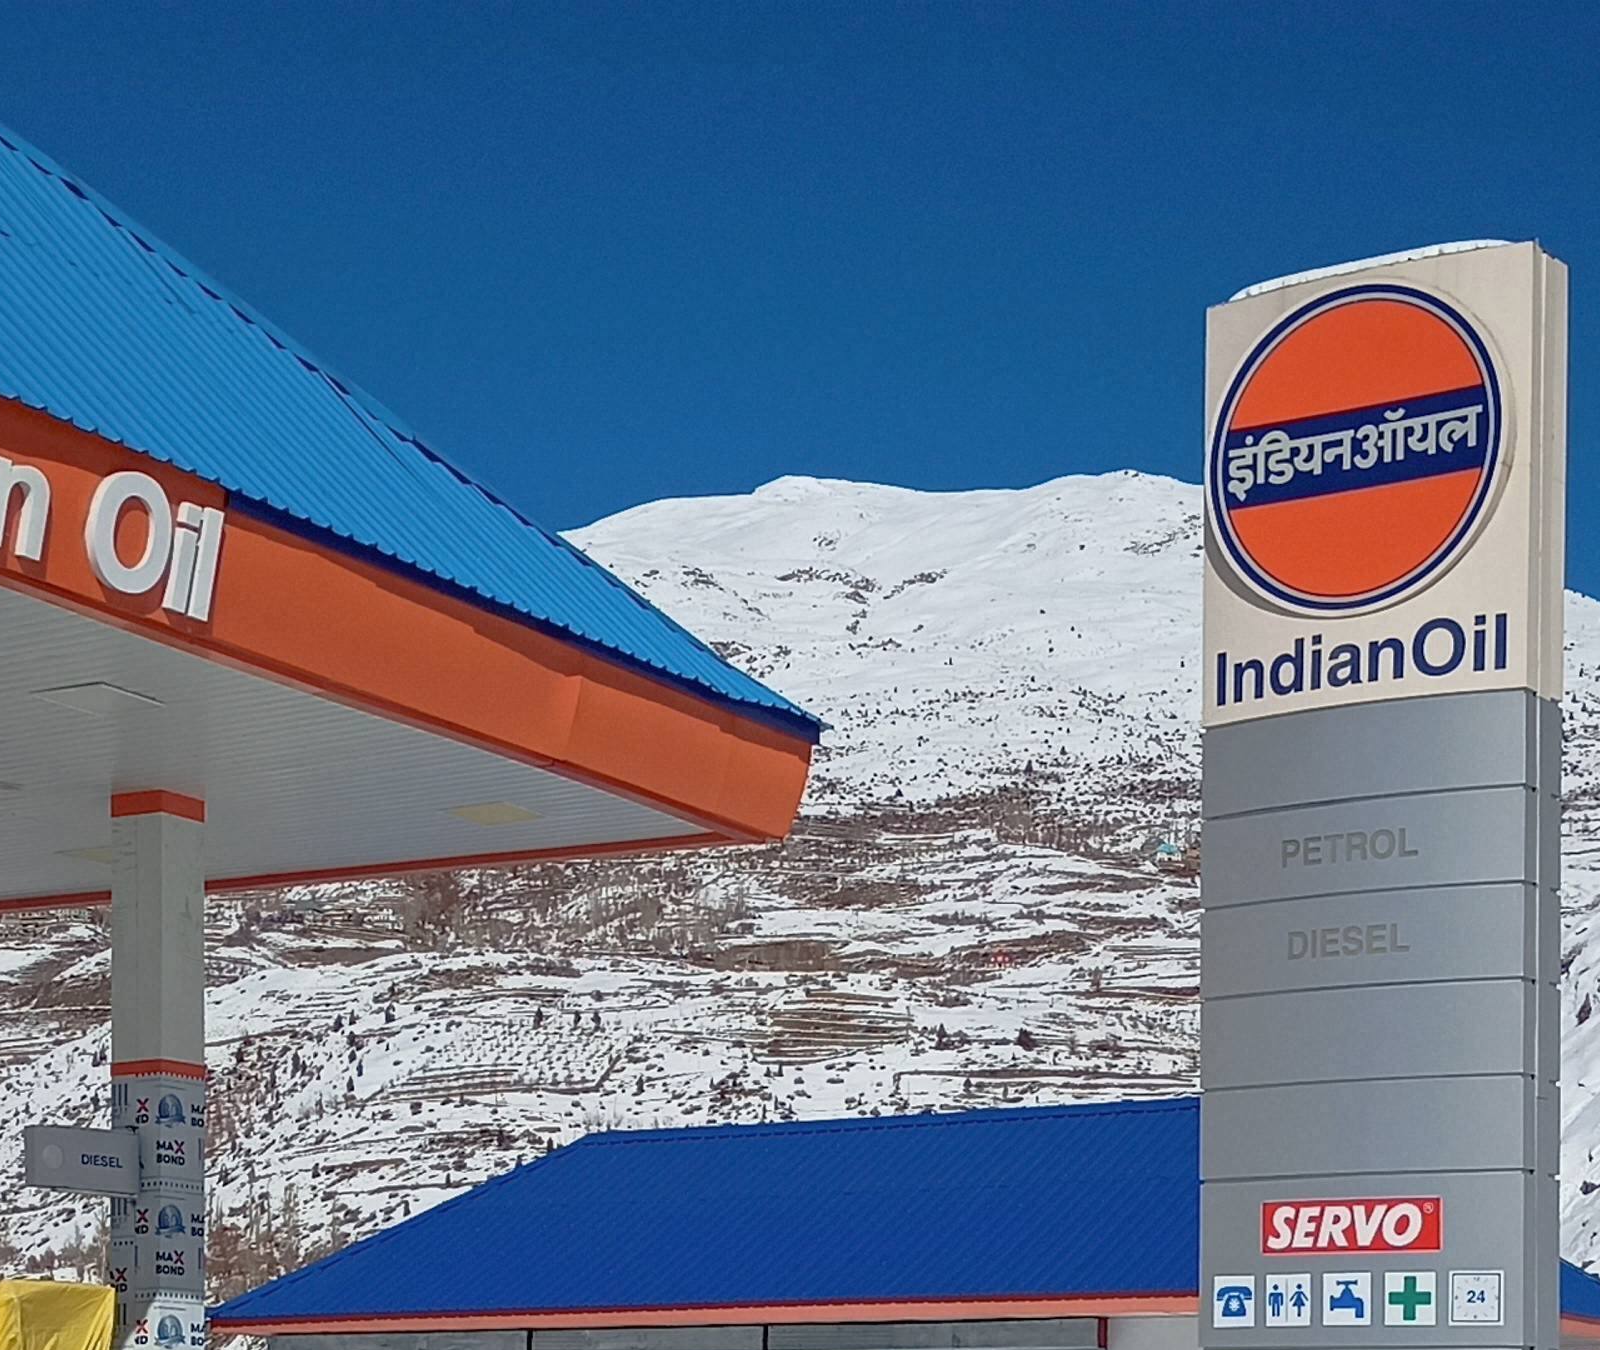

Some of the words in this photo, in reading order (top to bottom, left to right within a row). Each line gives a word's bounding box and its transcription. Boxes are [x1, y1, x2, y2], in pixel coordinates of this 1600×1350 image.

[1228, 404, 1483, 502] इंडियनऑयल
[85, 471, 225, 622] Oil
[1216, 613, 1508, 707] IndianOil
[1281, 828, 1419, 868] PETROL
[1287, 923, 1410, 960] DIESEL
[156, 1140, 185, 1155] MAX
[81, 1153, 123, 1169] DIESEL
[156, 1154, 185, 1166] BOND
[156, 1250, 185, 1265] MAX
[155, 1264, 185, 1276] BOND
[1466, 1290, 1485, 1304] 24
